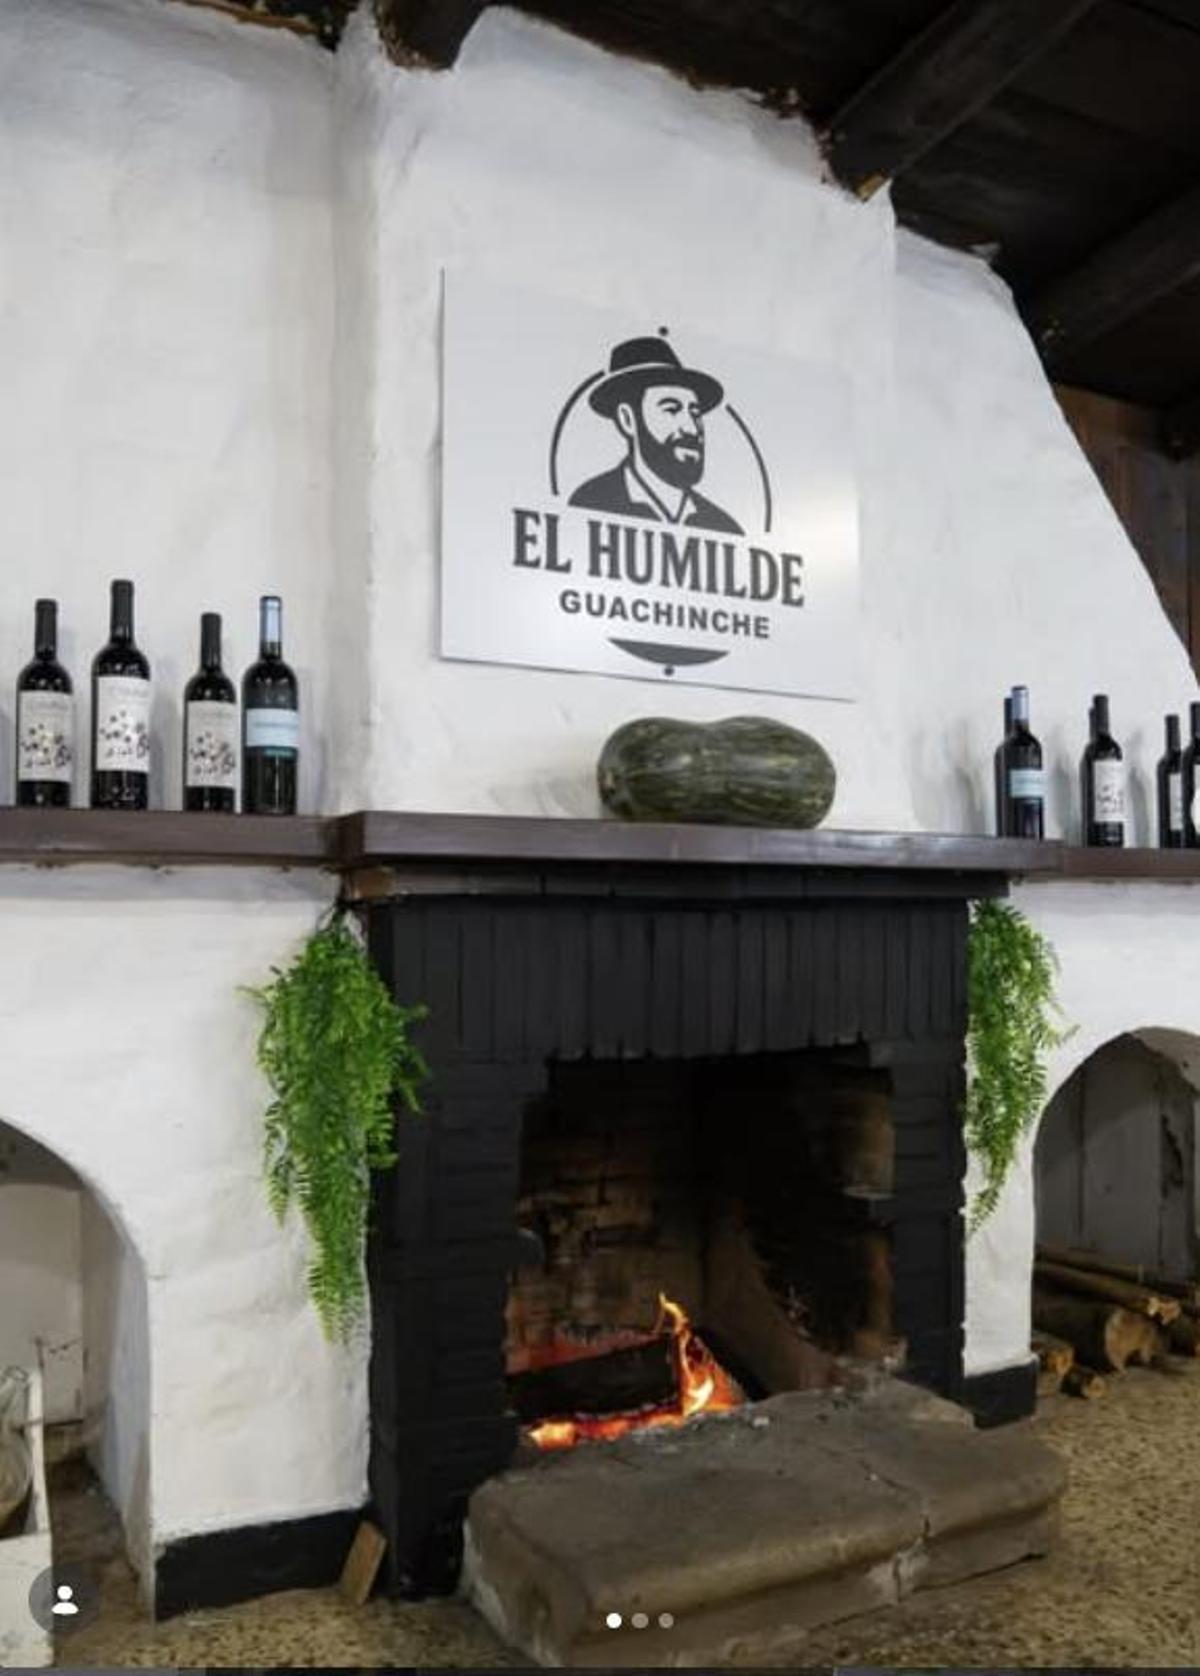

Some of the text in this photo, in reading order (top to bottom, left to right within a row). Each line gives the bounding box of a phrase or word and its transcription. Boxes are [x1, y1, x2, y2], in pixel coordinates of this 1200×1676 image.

[512, 508, 806, 608] EL HUMILDE
[559, 589, 770, 639] GUACHINCHE
